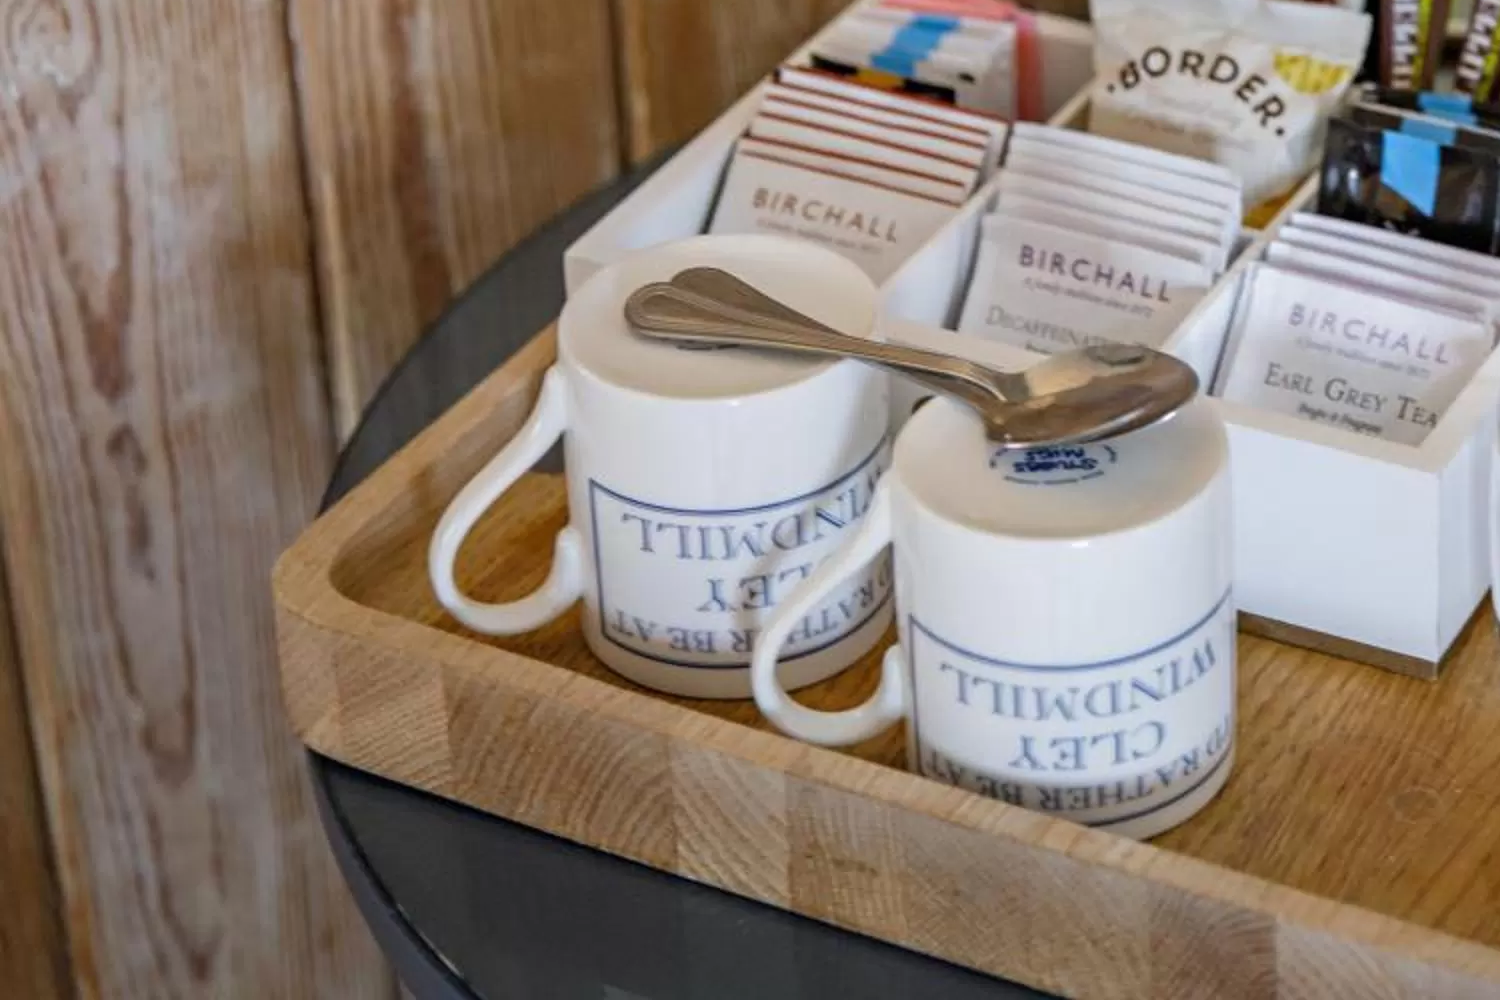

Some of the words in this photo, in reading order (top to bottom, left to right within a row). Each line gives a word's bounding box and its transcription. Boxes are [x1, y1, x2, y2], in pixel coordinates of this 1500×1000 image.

[1118, 46, 1286, 128] BORDER
[752, 186, 898, 244] BIRCHALL
[1018, 244, 1172, 304] BIRCHALL
[1287, 302, 1450, 365] BIRCHALL
[695, 559, 814, 613] LEY
[611, 607, 655, 643] AT
[664, 625, 717, 654] BE
[730, 579, 875, 653] RATHR
[938, 637, 1218, 724] WINDMILL
[1007, 719, 1169, 773] CLEY
[975, 774, 1023, 807] BE
[1040, 746, 1202, 813] RATHER
